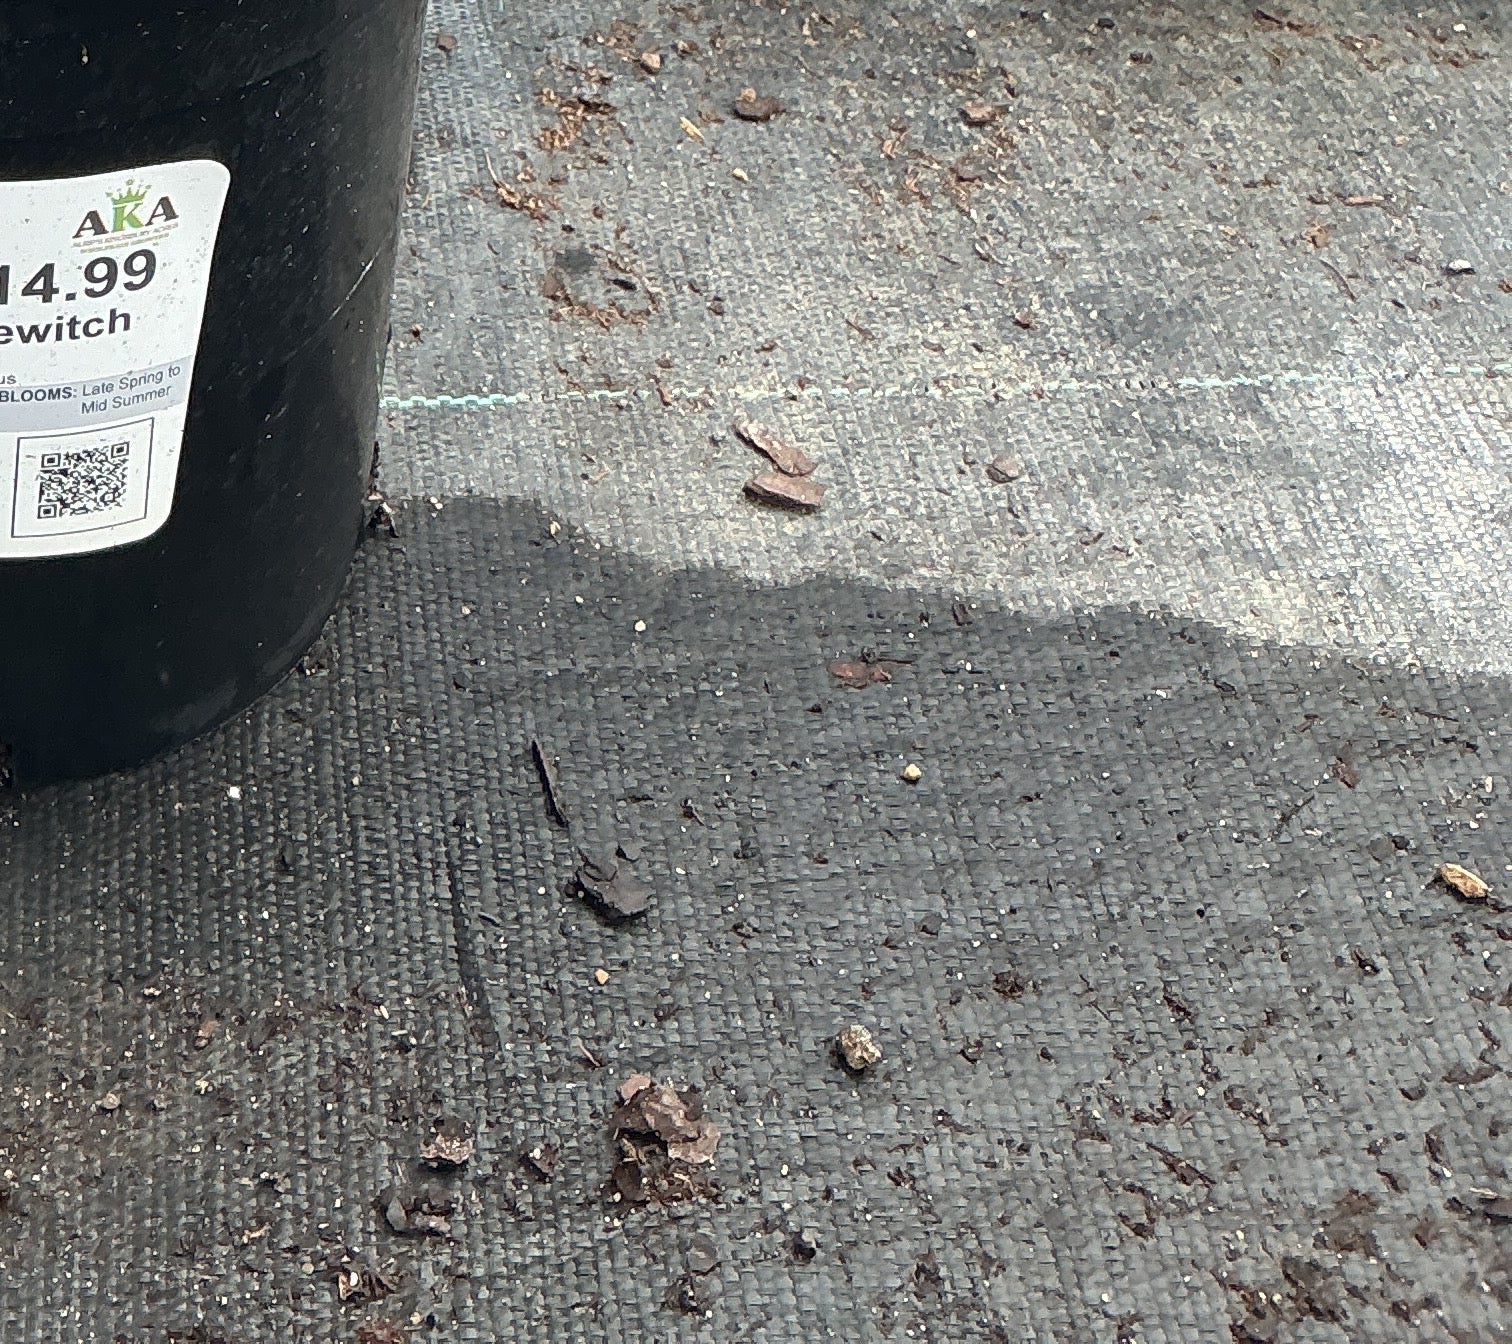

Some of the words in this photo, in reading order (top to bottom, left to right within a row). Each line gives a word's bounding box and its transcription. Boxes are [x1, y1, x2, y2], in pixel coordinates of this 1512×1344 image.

[72, 195, 179, 238] AKA
[83, 382, 114, 397] Late
[119, 371, 163, 390] Spring
[168, 364, 181, 378] to
[82, 399, 106, 414] Mid
[112, 385, 172, 409] Summer
